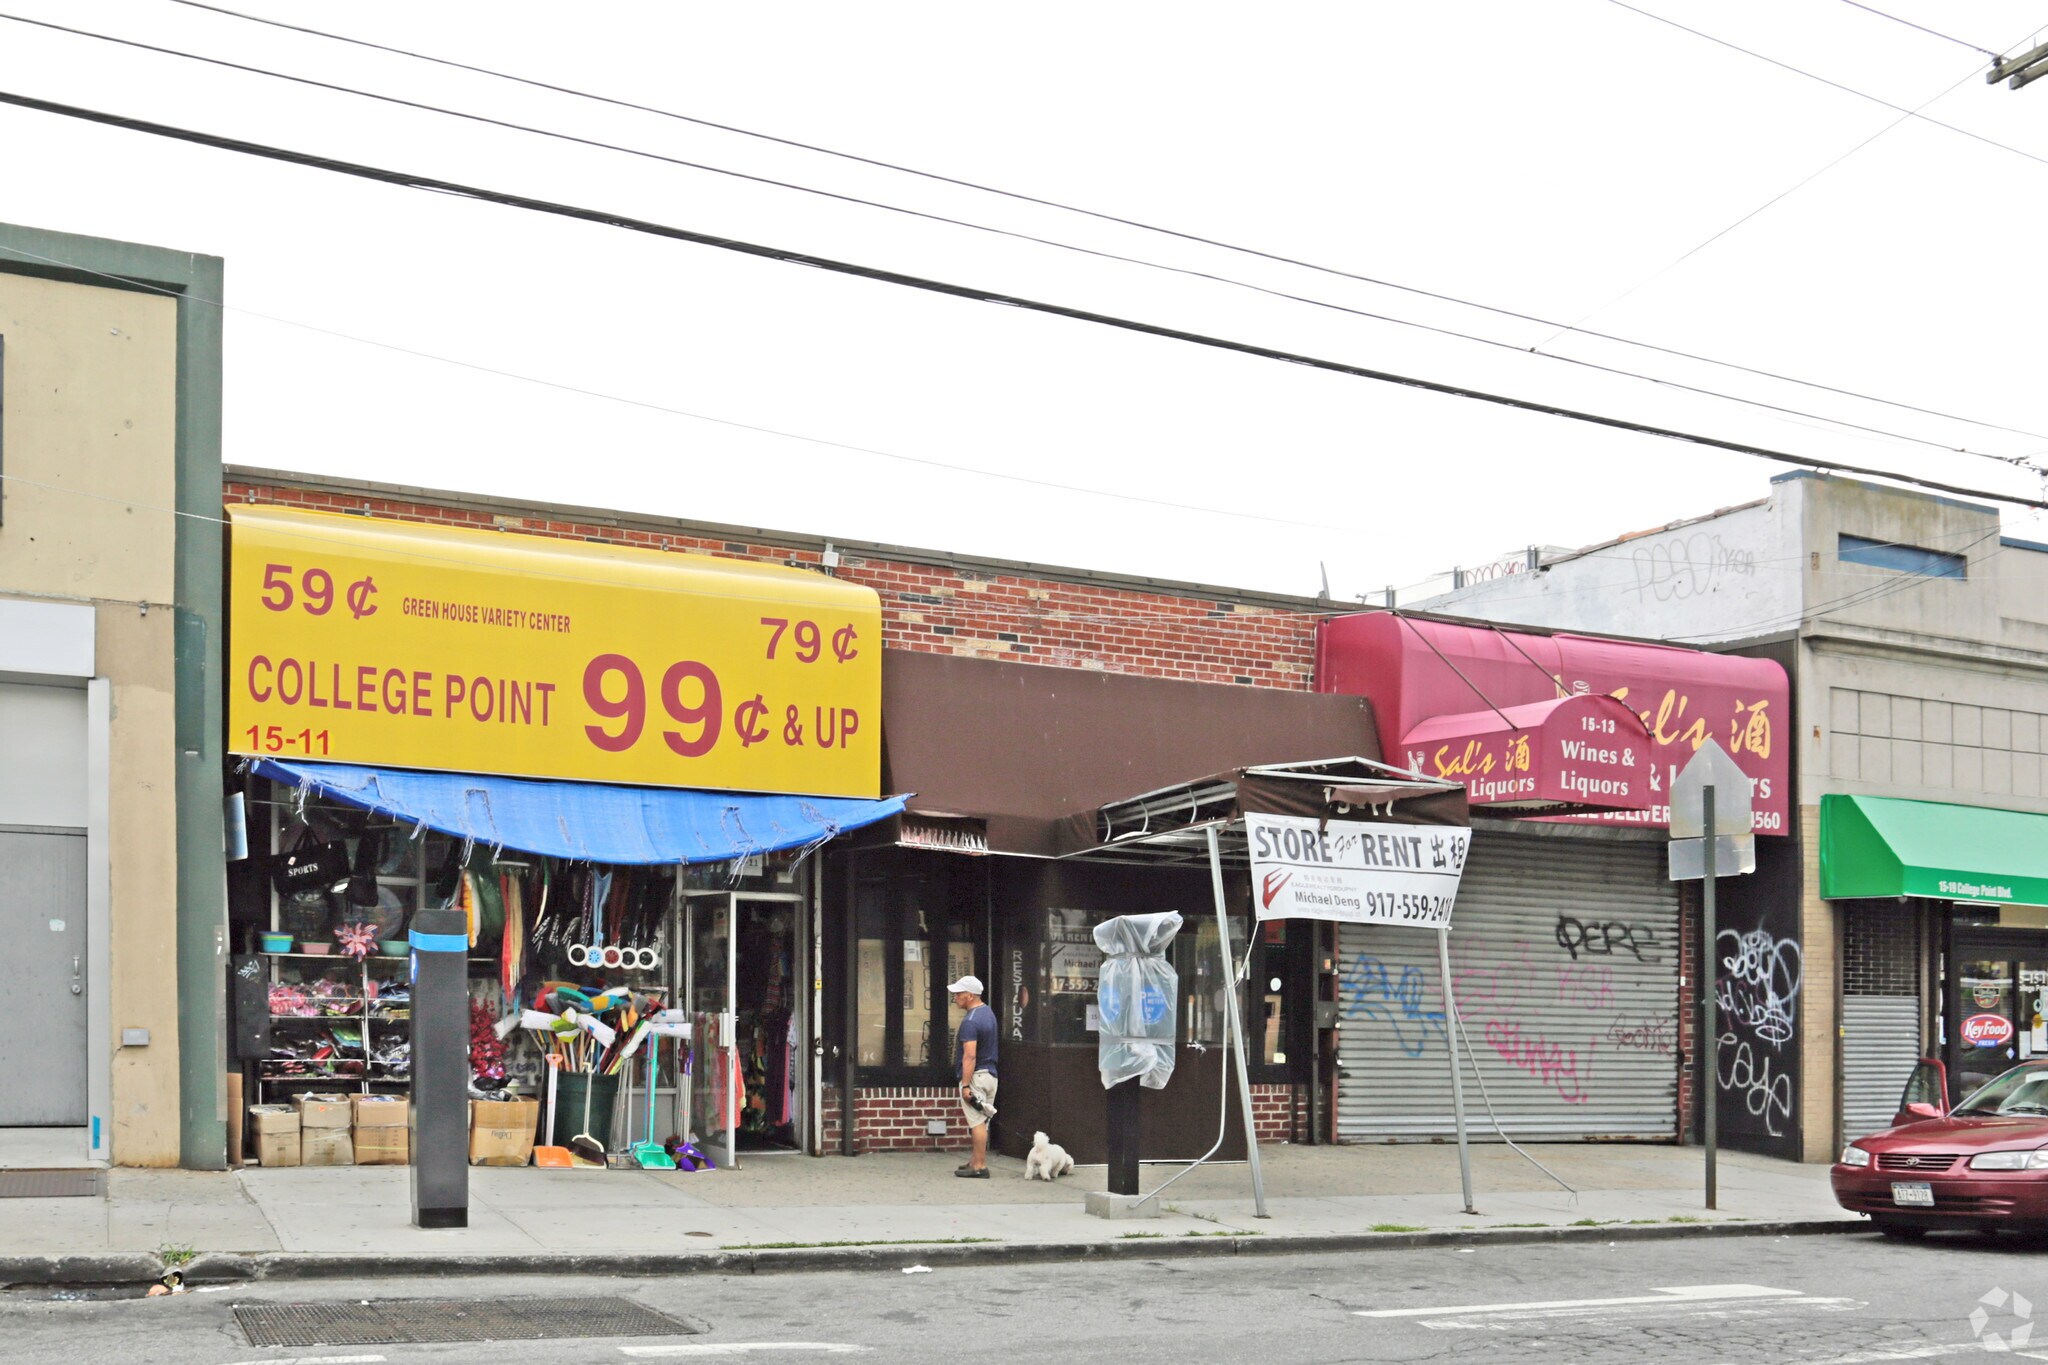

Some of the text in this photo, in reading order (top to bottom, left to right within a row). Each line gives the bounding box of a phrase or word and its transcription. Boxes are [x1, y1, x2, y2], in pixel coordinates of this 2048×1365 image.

[402, 597, 571, 633] GREEN HOUSE VARIETY CENTER
[248, 655, 556, 727] COLLEGE POINT
[246, 725, 329, 755] 15-11
[783, 704, 804, 746] &
[816, 706, 859, 748] UP
[1581, 716, 1616, 734] 15-13
[1730, 699, 1771, 759] 酒
[1434, 740, 1496, 779] Sal's
[1505, 735, 1531, 772] 酒
[1561, 740, 1635, 767] Wines &
[1471, 777, 1535, 800] Liquors
[1561, 771, 1629, 798] Liquors
[1255, 826, 1333, 863] STORE
[1361, 833, 1422, 869] RENT
[1430, 834, 1466, 870] 出租
[288, 863, 318, 877] SPORTS
[1294, 891, 1361, 910] Michael Deng
[1958, 882, 1980, 897] College
[1981, 884, 1997, 897] Point
